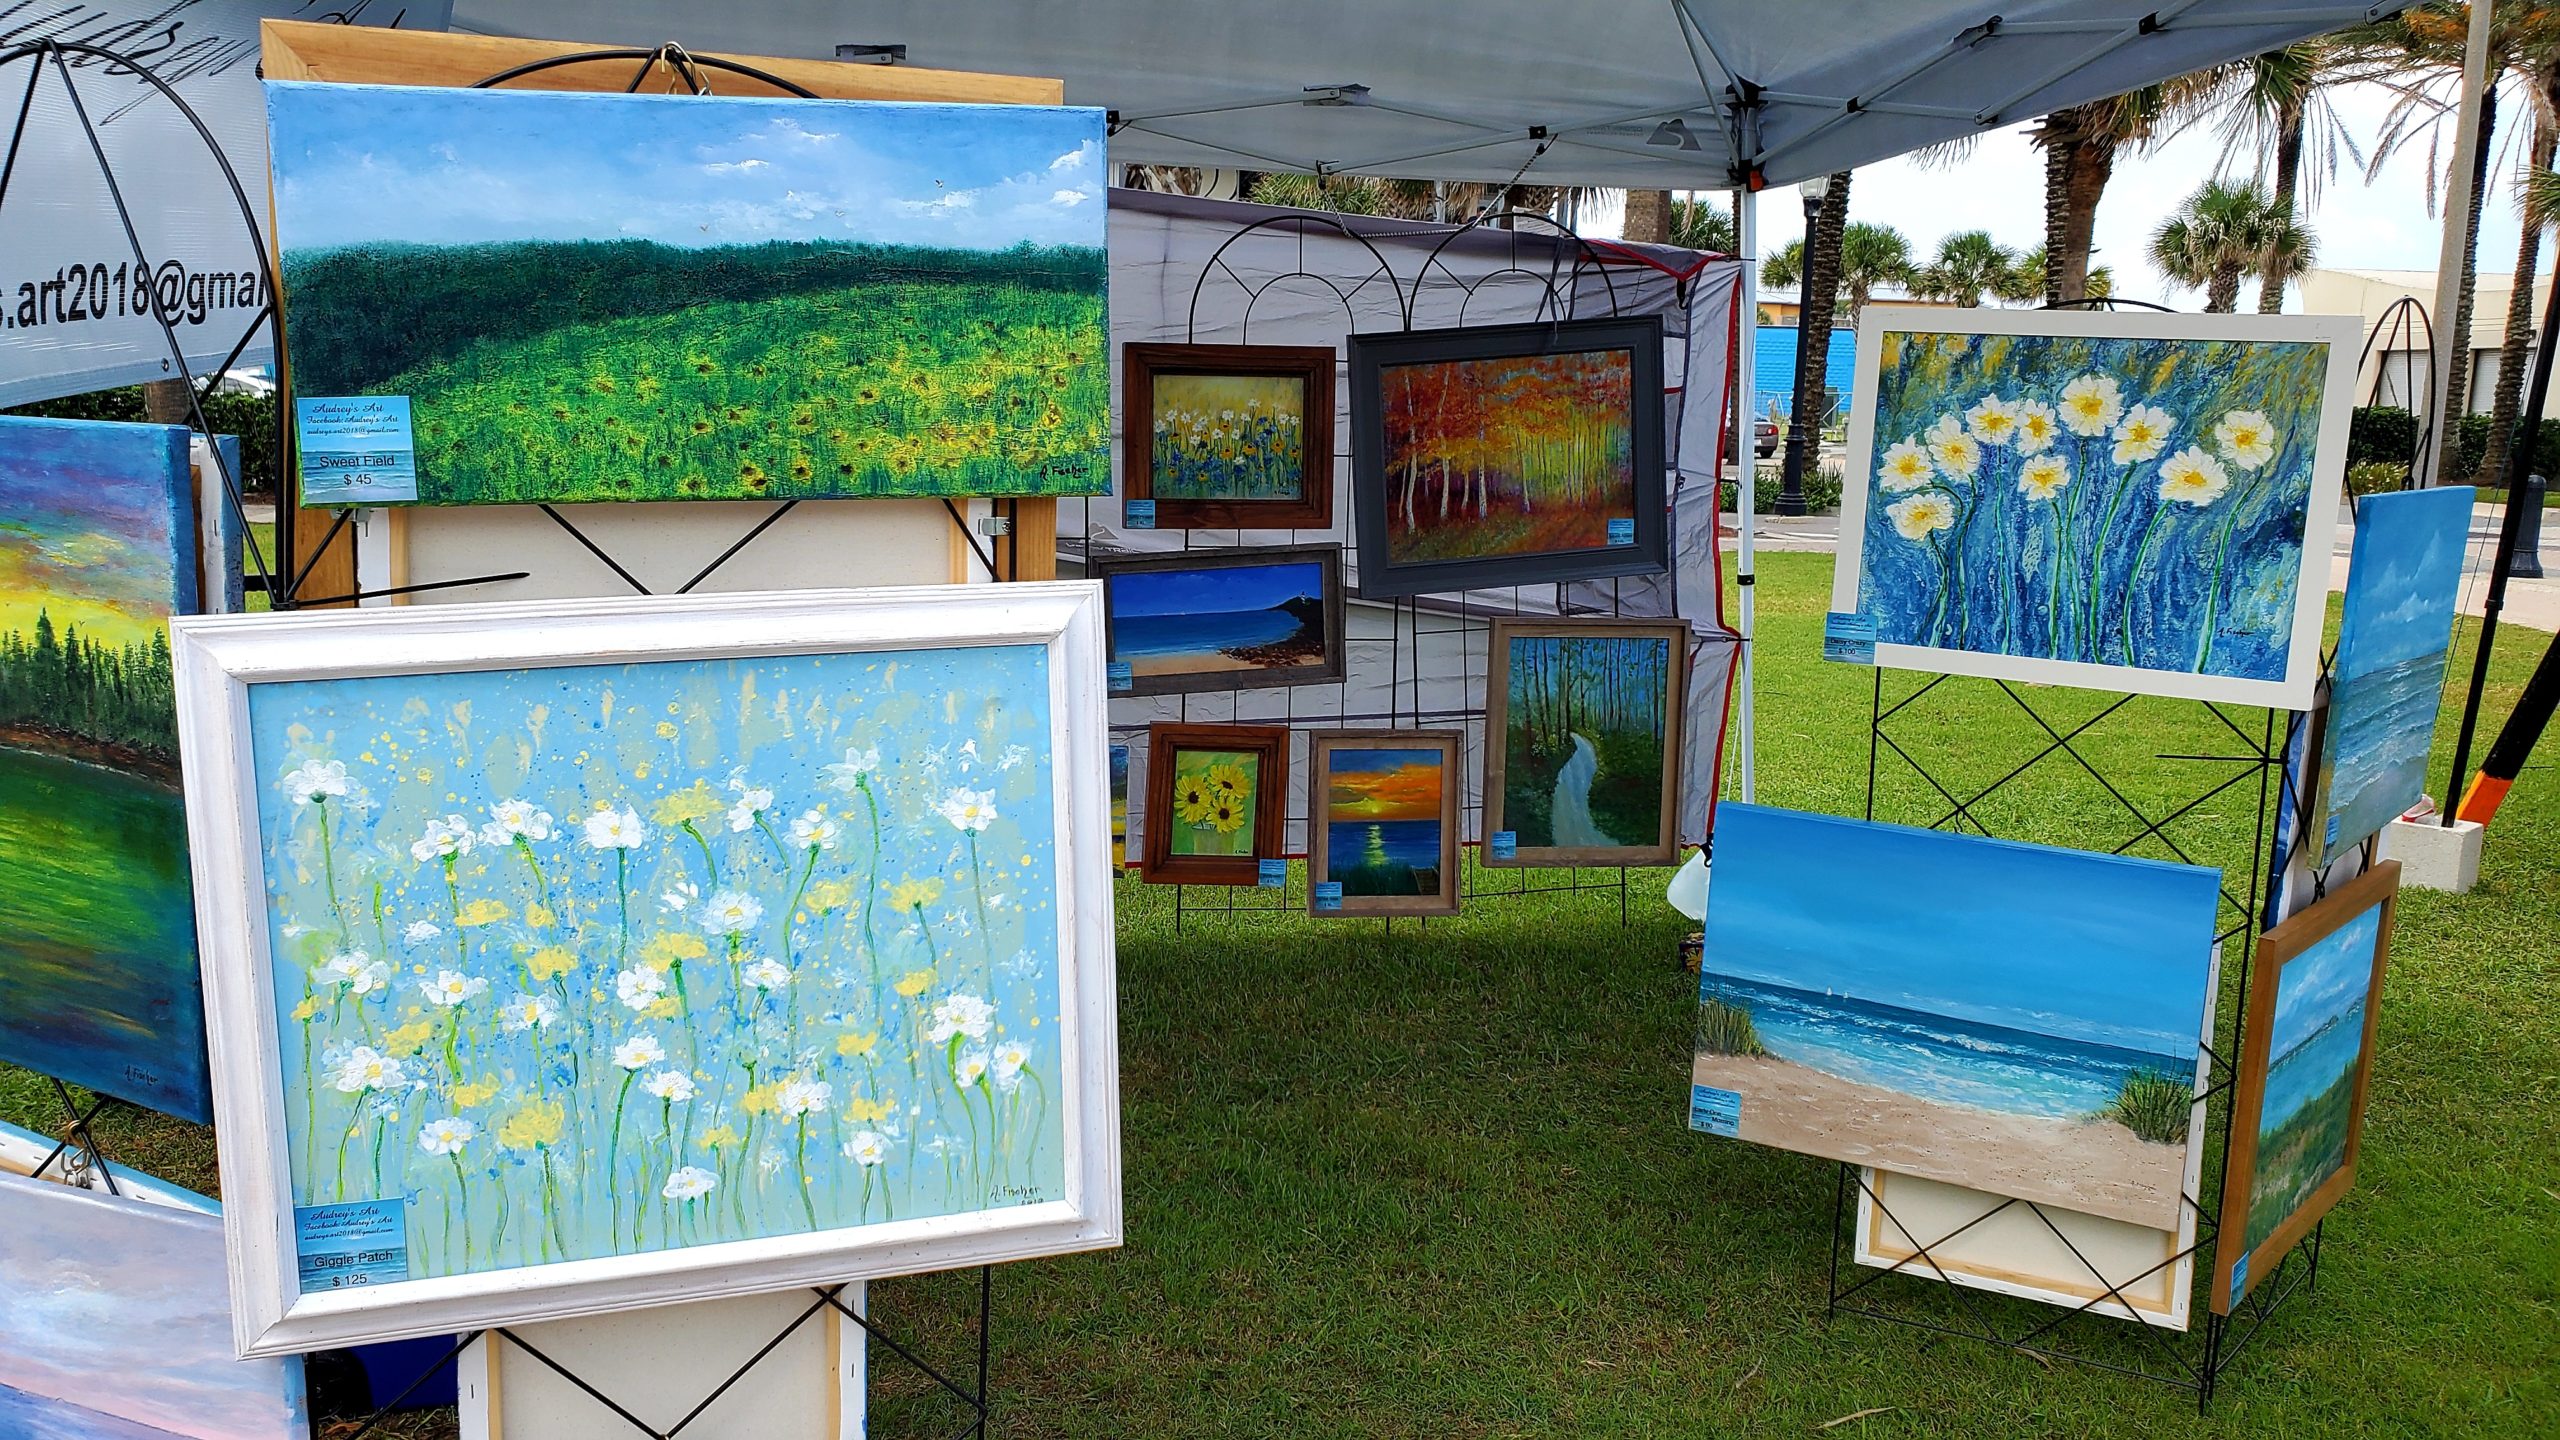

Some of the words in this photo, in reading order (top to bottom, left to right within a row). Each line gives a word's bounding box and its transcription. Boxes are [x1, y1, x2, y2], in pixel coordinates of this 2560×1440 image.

[312, 402, 359, 416] Audrey's
[362, 402, 384, 412] Art
[345, 415, 379, 425] Audrey's
[382, 415, 398, 423] Art
[320, 456, 360, 468] Sweet
[363, 455, 395, 466] Field
[343, 474, 352, 485] $
[355, 474, 372, 485] 45
[310, 1207, 356, 1221] Audrey's
[359, 1206, 380, 1216] Art
[341, 1217, 375, 1227] Audrey's
[377, 1216, 393, 1224] Art
[314, 1254, 354, 1268] Giggle
[358, 1250, 393, 1263] Patch
[332, 1276, 341, 1287] $
[344, 1273, 368, 1285] 125
